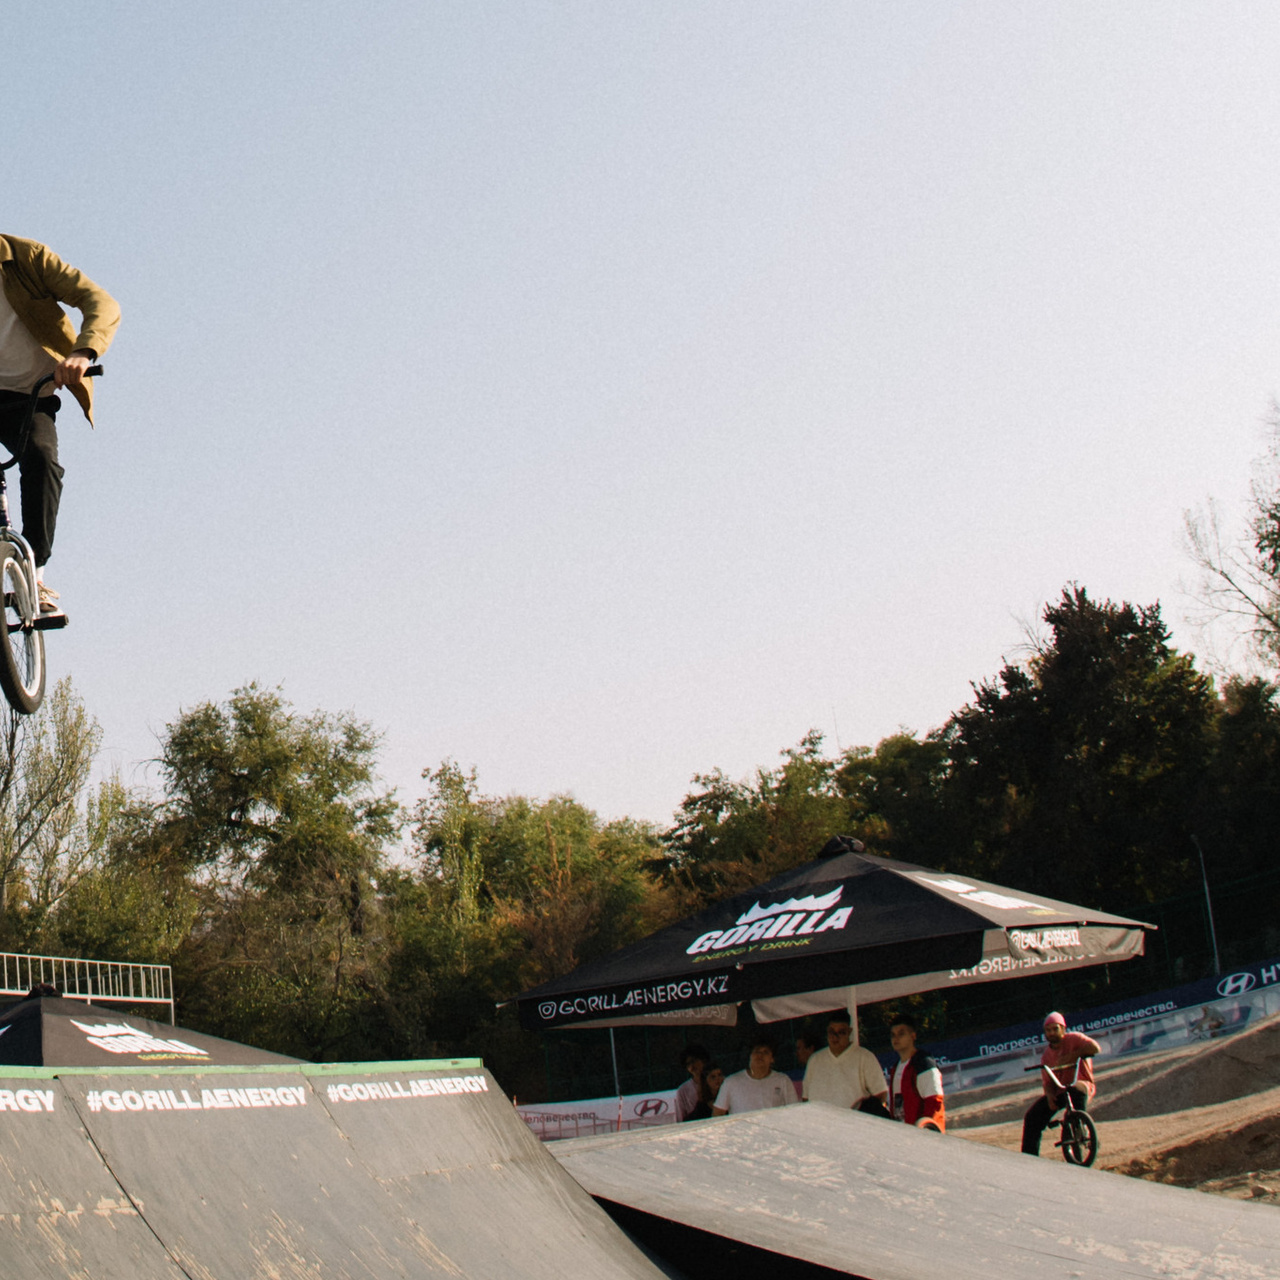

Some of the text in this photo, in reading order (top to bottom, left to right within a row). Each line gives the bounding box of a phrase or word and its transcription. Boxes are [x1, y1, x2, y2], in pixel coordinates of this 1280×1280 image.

[686, 906, 854, 955] GORILLA
[760, 937, 814, 951] DRINK
[979, 1034, 1040, 1056] Прогресс
[1087, 1000, 1177, 1030] человечества.
[86, 1086, 307, 1112] #GORILLAENERGY
[327, 1075, 490, 1103] #GORILLAENERGY
